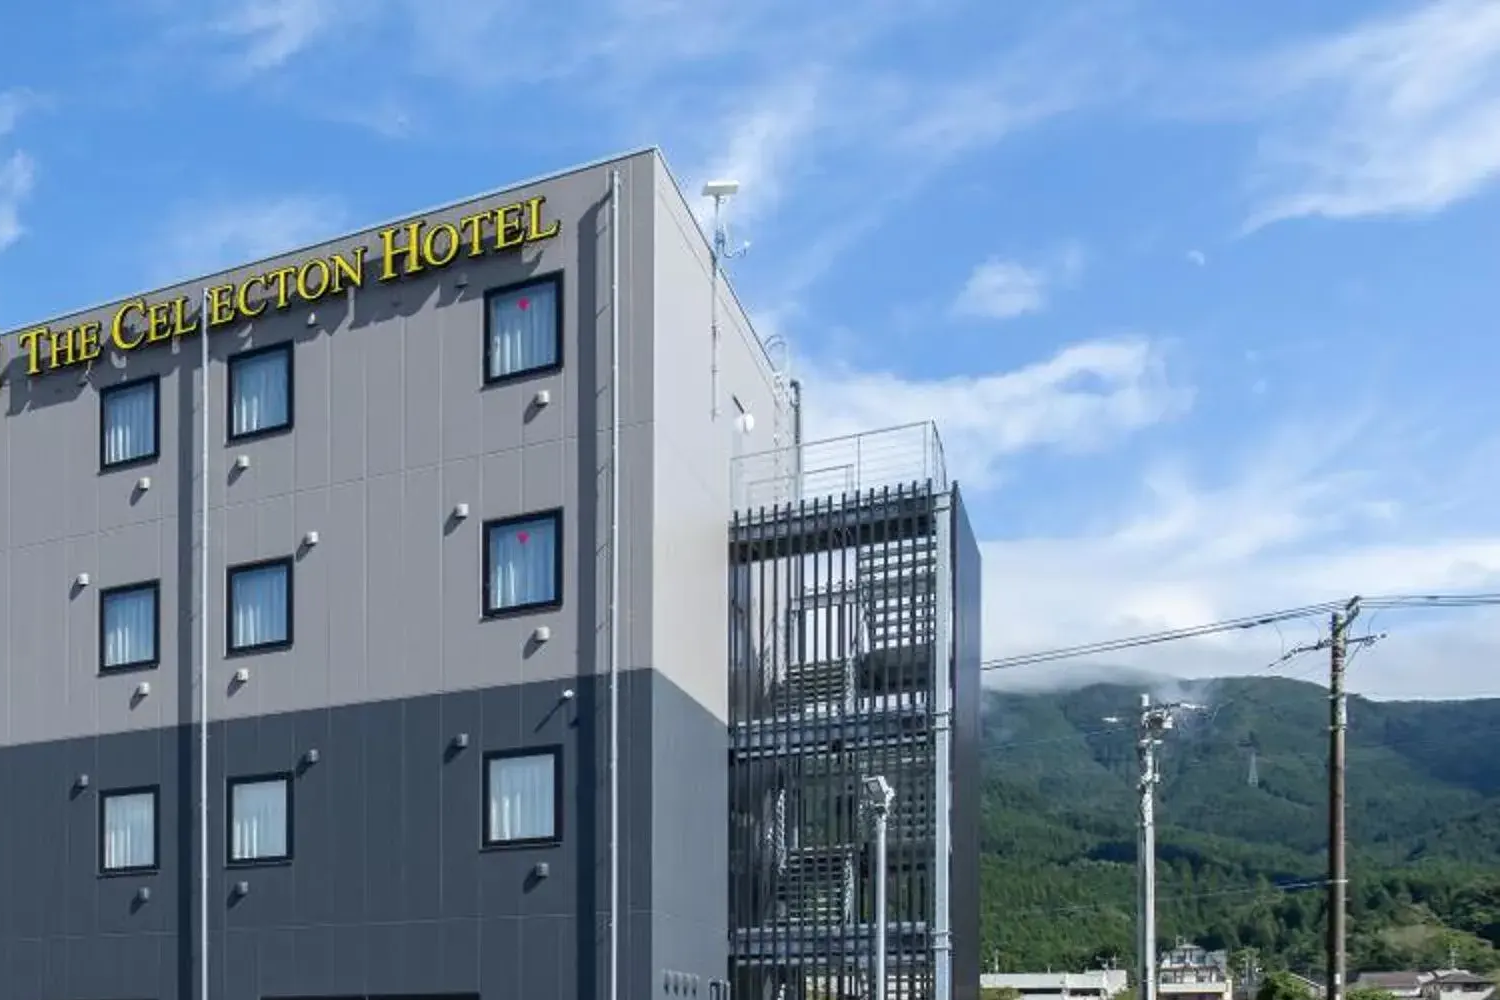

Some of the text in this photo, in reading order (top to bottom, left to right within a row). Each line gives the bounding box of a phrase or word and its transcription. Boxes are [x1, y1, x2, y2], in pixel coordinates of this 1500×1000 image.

[19, 196, 561, 376] THE CELECTON HOTEL
